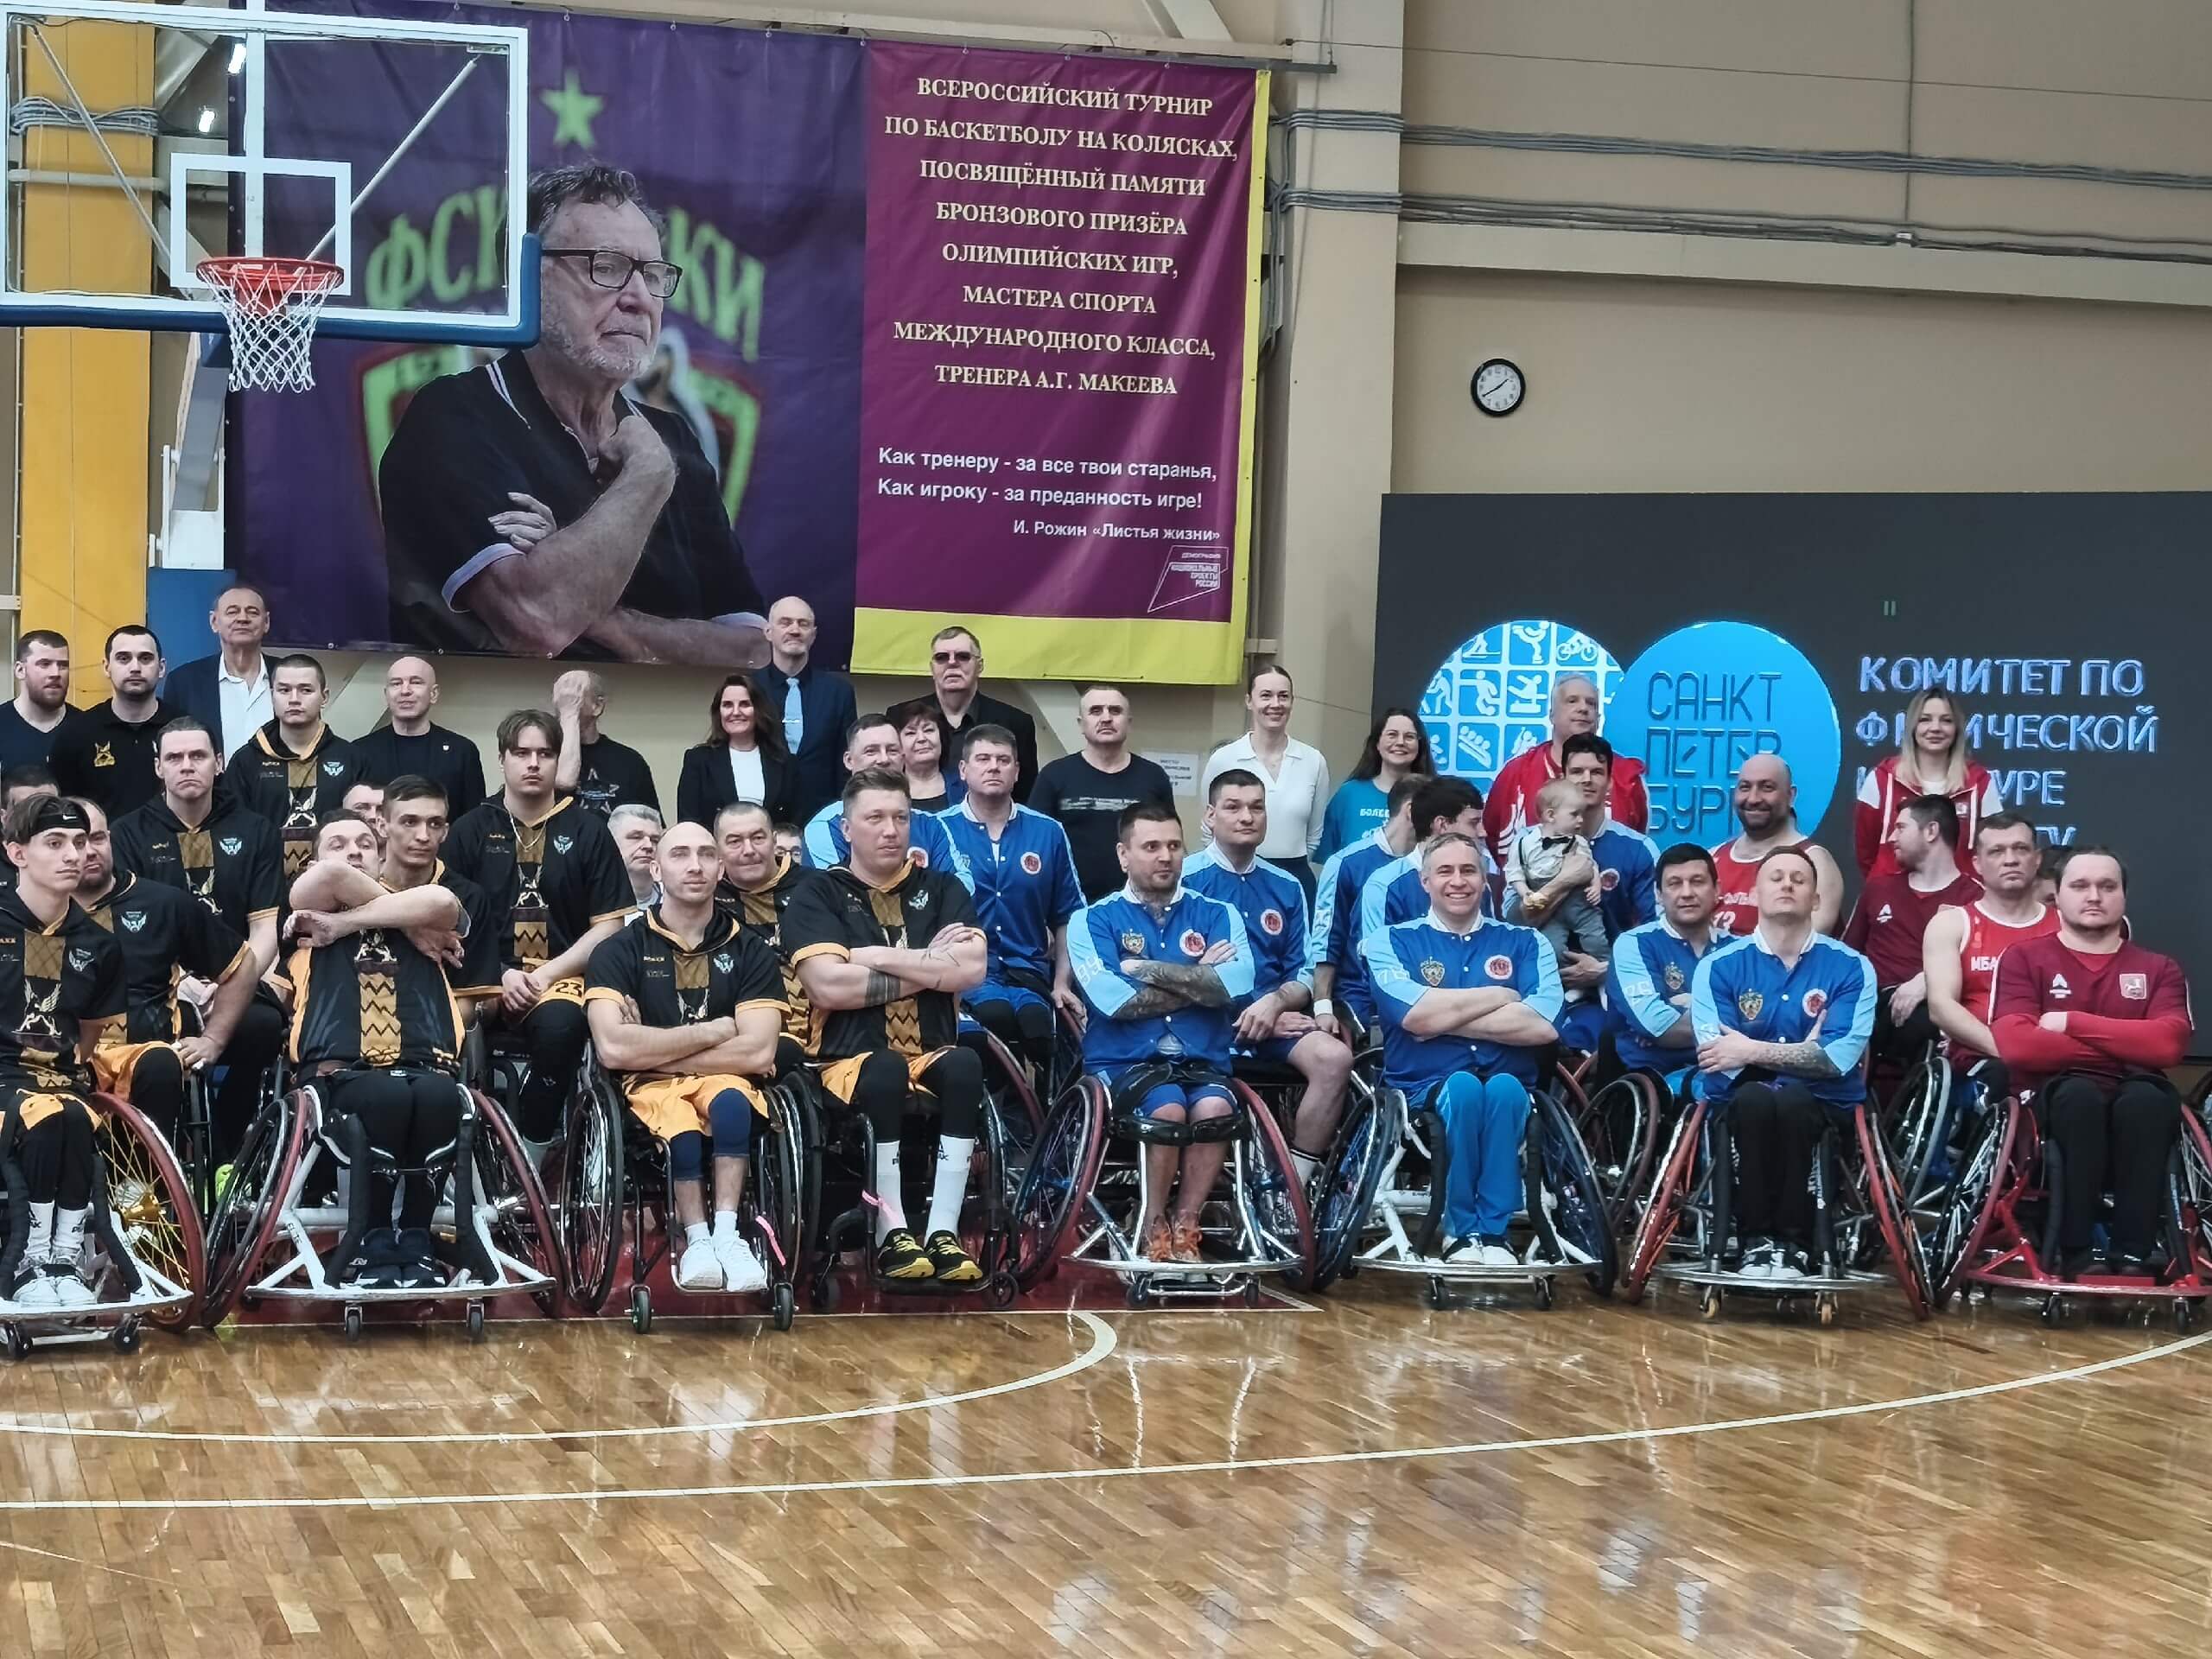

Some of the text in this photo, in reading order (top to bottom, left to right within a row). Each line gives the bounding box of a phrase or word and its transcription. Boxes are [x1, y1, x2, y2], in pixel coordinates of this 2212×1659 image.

[917, 77, 1213, 116] ВСЕРОССИЙСКИЙ ТУРНИР
[884, 116, 1237, 162] ПО БАСКЕТБОЛУ НА КОЛЯСКАХ,
[919, 159, 1206, 196] ПОСВЯЩЁННЫЙ ПАМЯТИ
[936, 201, 1188, 235] БРОНЗОВОГО ПРИЗЁРА
[942, 243, 1178, 279] ОЛИМПИЙСКИХ ИГР,
[963, 285, 1157, 314] МАСТЕРА СПОРТА
[893, 321, 1216, 360] МЕЖДУНАРОДНОГО КЛАССА,
[934, 365, 1178, 395] ТРЕНЕРА А.Г. МАКЕЕВА
[879, 447, 916, 466] Как
[920, 453, 1000, 474] тренеру
[1015, 458, 1036, 472] за
[1042, 460, 1074, 474] все
[1078, 461, 1122, 476] твои
[1127, 462, 1217, 482] старанья,
[878, 478, 914, 496] Как
[919, 483, 988, 504] игроку
[1004, 487, 1025, 501] за
[1030, 489, 1153, 506] преданность
[1157, 492, 1202, 512] игре!
[1014, 519, 1221, 541] И. Рожин «Листья жизни»
[1859, 656, 2145, 697] КОМИТЕТ ПО
[1648, 671, 1783, 721] САНКТ
[1855, 705, 2160, 753] ФИЧЕСКОЙ
